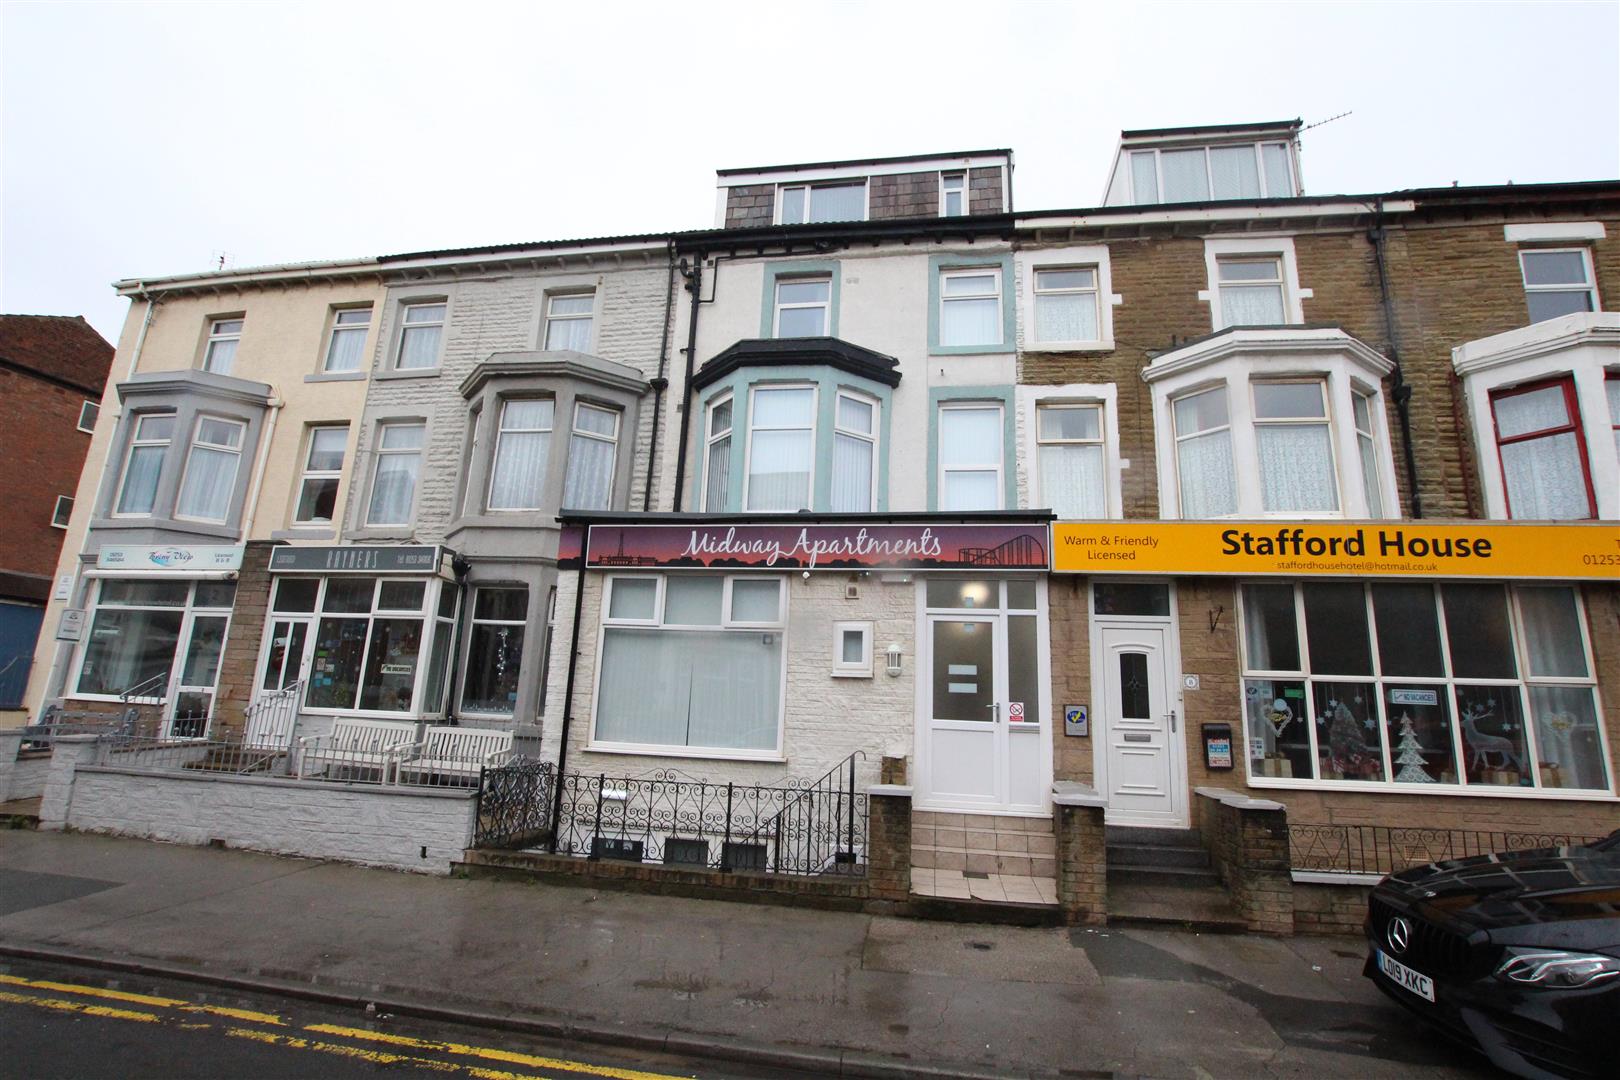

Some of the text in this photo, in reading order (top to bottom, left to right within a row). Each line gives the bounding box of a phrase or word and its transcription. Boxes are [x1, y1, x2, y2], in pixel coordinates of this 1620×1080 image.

[681, 527, 942, 568] Midway Apartments
[1064, 536, 1159, 549] Warm & Friendly
[1222, 529, 1492, 558] Stafford House
[326, 550, 379, 569] RAYNERS
[1088, 550, 1136, 560] Licensed
[1277, 561, 1438, 571] staffordhousehotel@hotmail.co.uk
[1403, 969, 1429, 996] XKC
